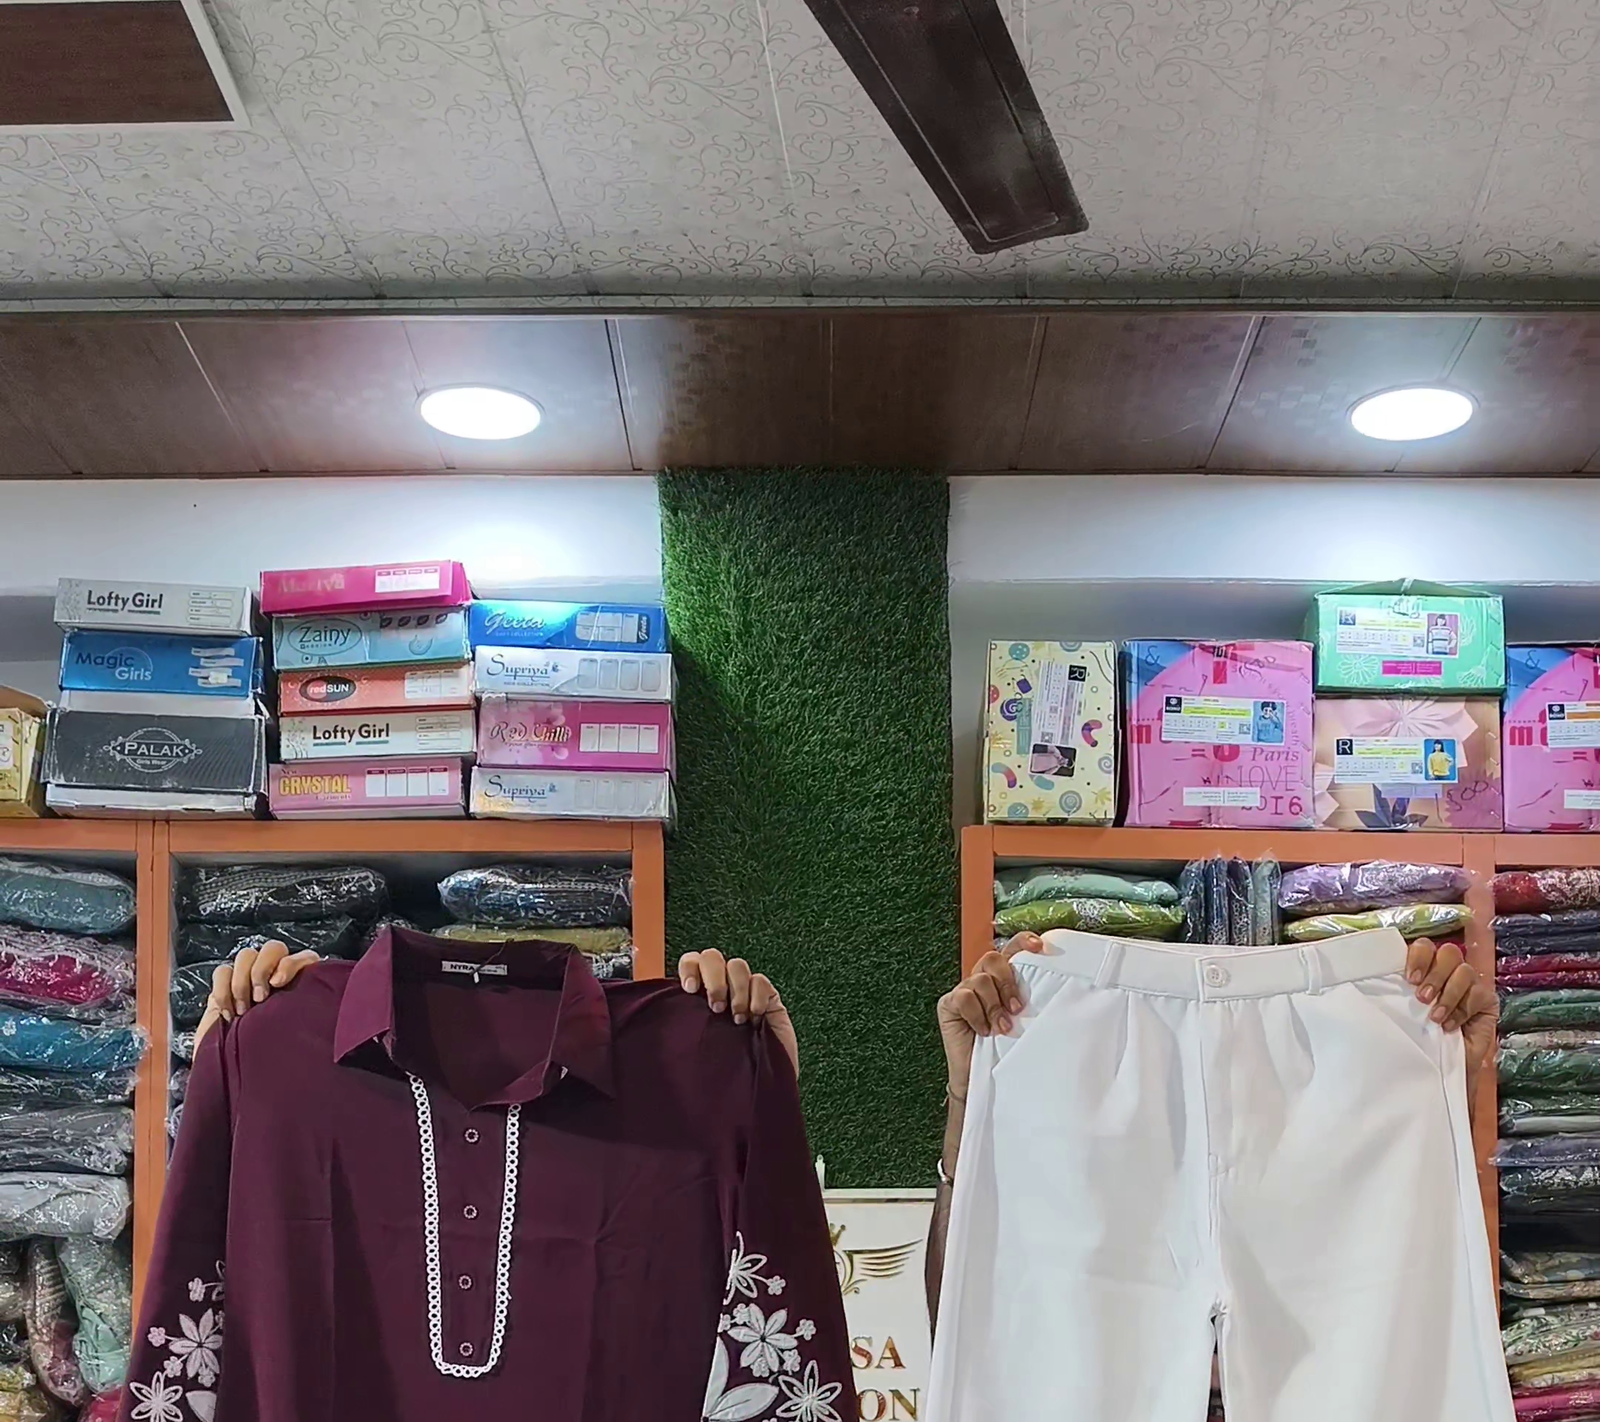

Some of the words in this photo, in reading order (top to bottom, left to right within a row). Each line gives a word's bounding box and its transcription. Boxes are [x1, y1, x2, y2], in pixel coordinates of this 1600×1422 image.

[87, 590, 130, 611] Lofty
[132, 593, 163, 609] Girl
[299, 625, 351, 647] Zainy
[75, 652, 135, 667] Magic
[487, 654, 548, 682] Supriya
[115, 667, 152, 681] Girls
[310, 683, 350, 695] redSUN
[312, 725, 356, 743] Lofty
[358, 723, 390, 738] Girl
[489, 721, 528, 742] Red
[532, 724, 571, 743] Chilli
[124, 742, 184, 757] PALAK
[1251, 747, 1300, 761] Paris
[279, 775, 352, 796] CRYSTAL
[484, 774, 546, 803] Supriya
[1241, 795, 1303, 816] 016
[450, 963, 475, 971] NYRA
[850, 1336, 907, 1371] SA
[858, 1388, 921, 1422] ON
